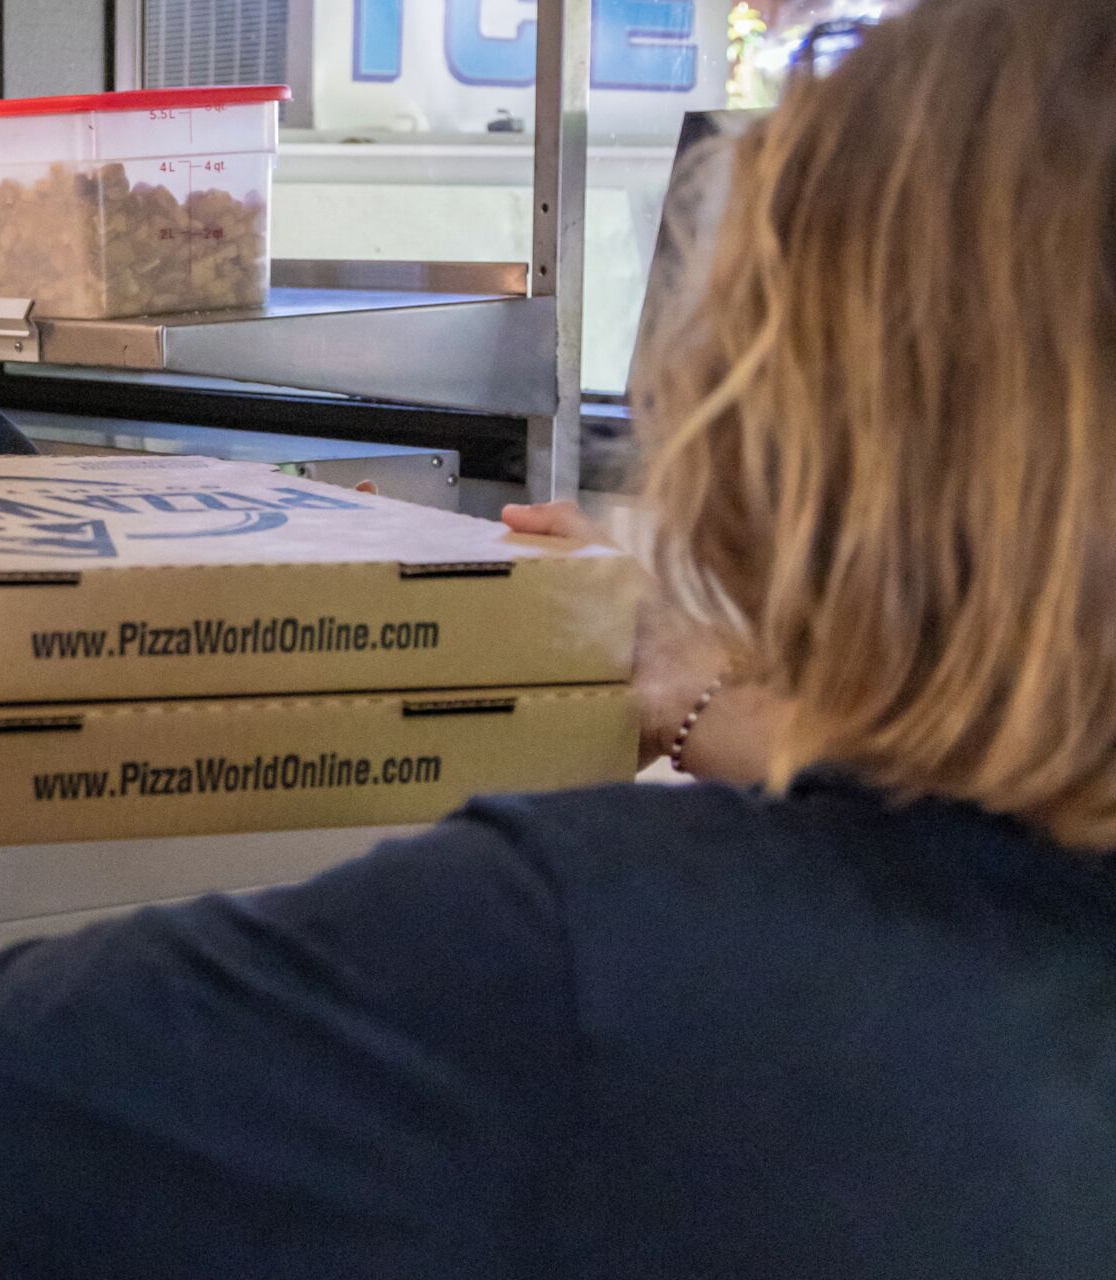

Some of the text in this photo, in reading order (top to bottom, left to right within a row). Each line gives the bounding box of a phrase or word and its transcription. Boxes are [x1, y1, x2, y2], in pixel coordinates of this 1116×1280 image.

[45, 487, 375, 514] PIZZA
[31, 616, 440, 659] www.PizzaWorldOnline.com
[33, 752, 442, 802] www.PizzaWorldOnline.com
